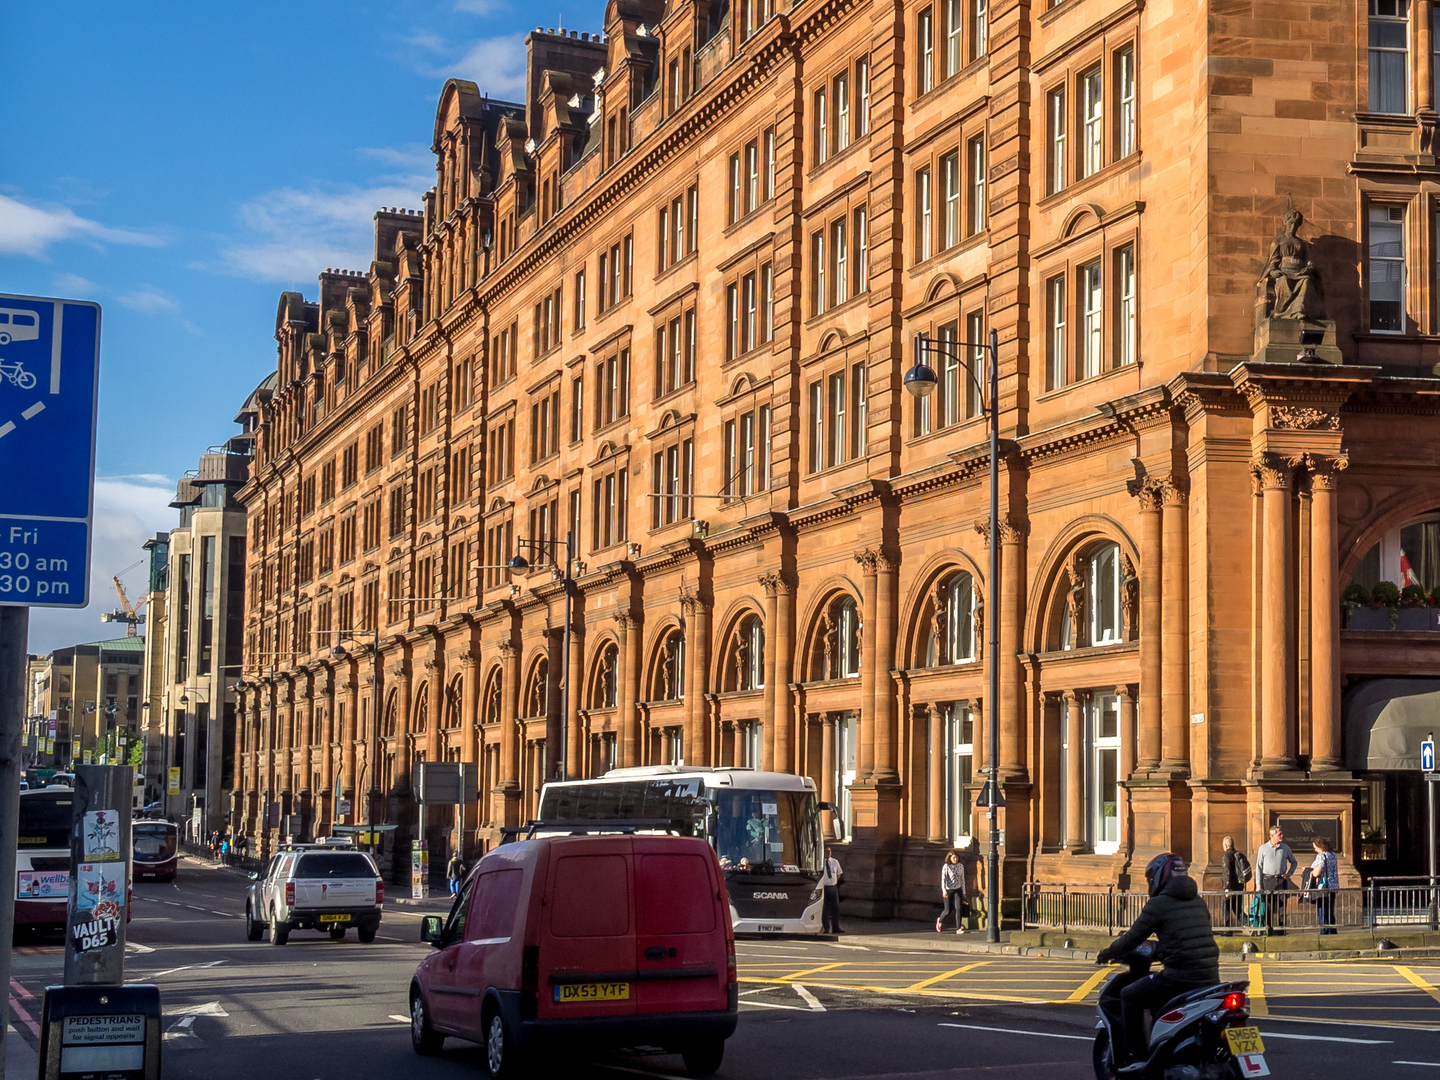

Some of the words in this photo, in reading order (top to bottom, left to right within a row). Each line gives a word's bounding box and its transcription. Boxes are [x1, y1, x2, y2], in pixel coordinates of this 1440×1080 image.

[10, 526, 38, 545] Fri
[35, 557, 68, 571] am
[36, 580, 70, 597] pm
[753, 891, 789, 900] SCANIA
[73, 917, 113, 939] VAULT
[82, 932, 109, 950] D65
[563, 985, 598, 998] DX53
[601, 983, 627, 996] YTF
[69, 1015, 141, 1025] PEDESTRIANS
[83, 1033, 105, 1041] signal
[1227, 1027, 1258, 1040] SM66
[1234, 1040, 1259, 1052] YZX
[1243, 1055, 1261, 1071] L
